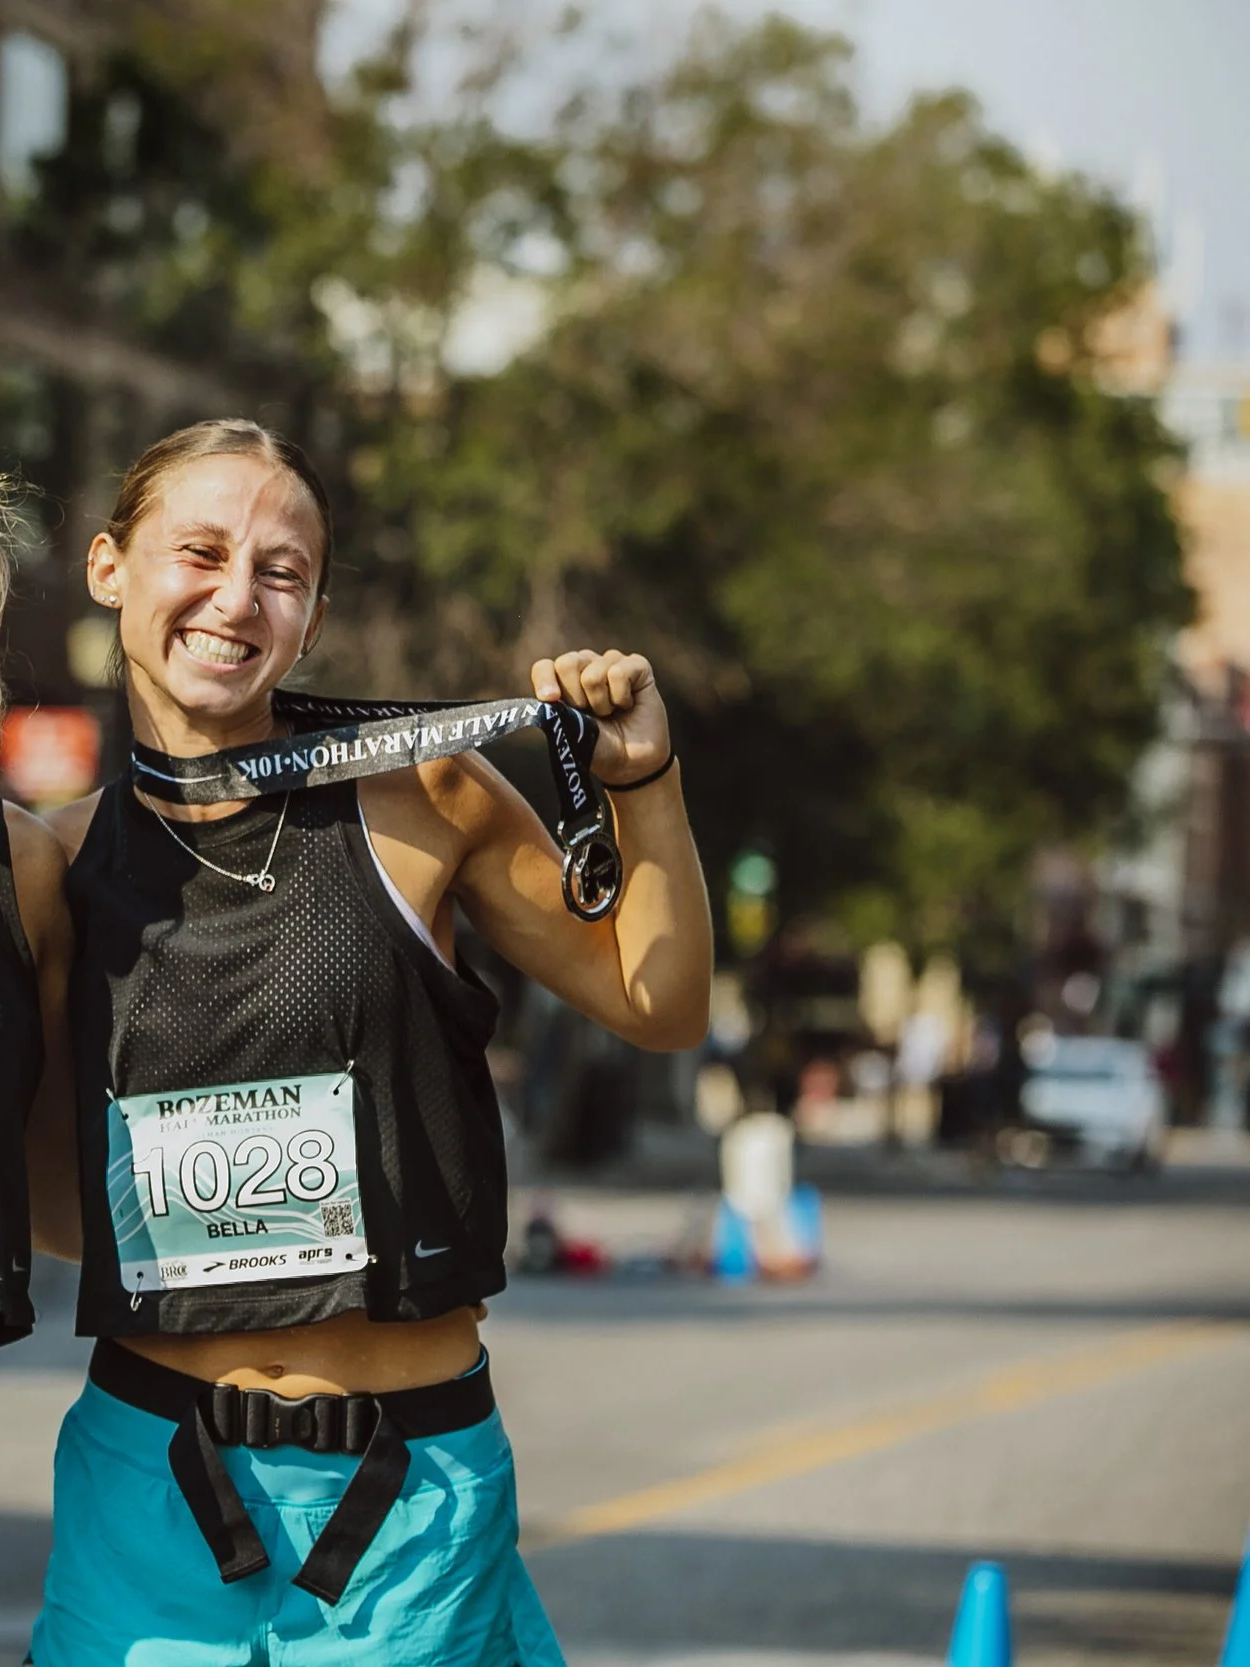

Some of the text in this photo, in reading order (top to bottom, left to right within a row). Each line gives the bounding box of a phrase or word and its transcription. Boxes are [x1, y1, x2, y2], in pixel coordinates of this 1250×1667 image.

[448, 708, 512, 741] HALF
[156, 1084, 302, 1120] BOZEMAN
[206, 1106, 301, 1126] MARATHON
[131, 1129, 338, 1217] 1028
[206, 1219, 269, 1239] BELLA
[229, 1254, 287, 1270] BROOKS
[298, 1247, 333, 1261] aprs
